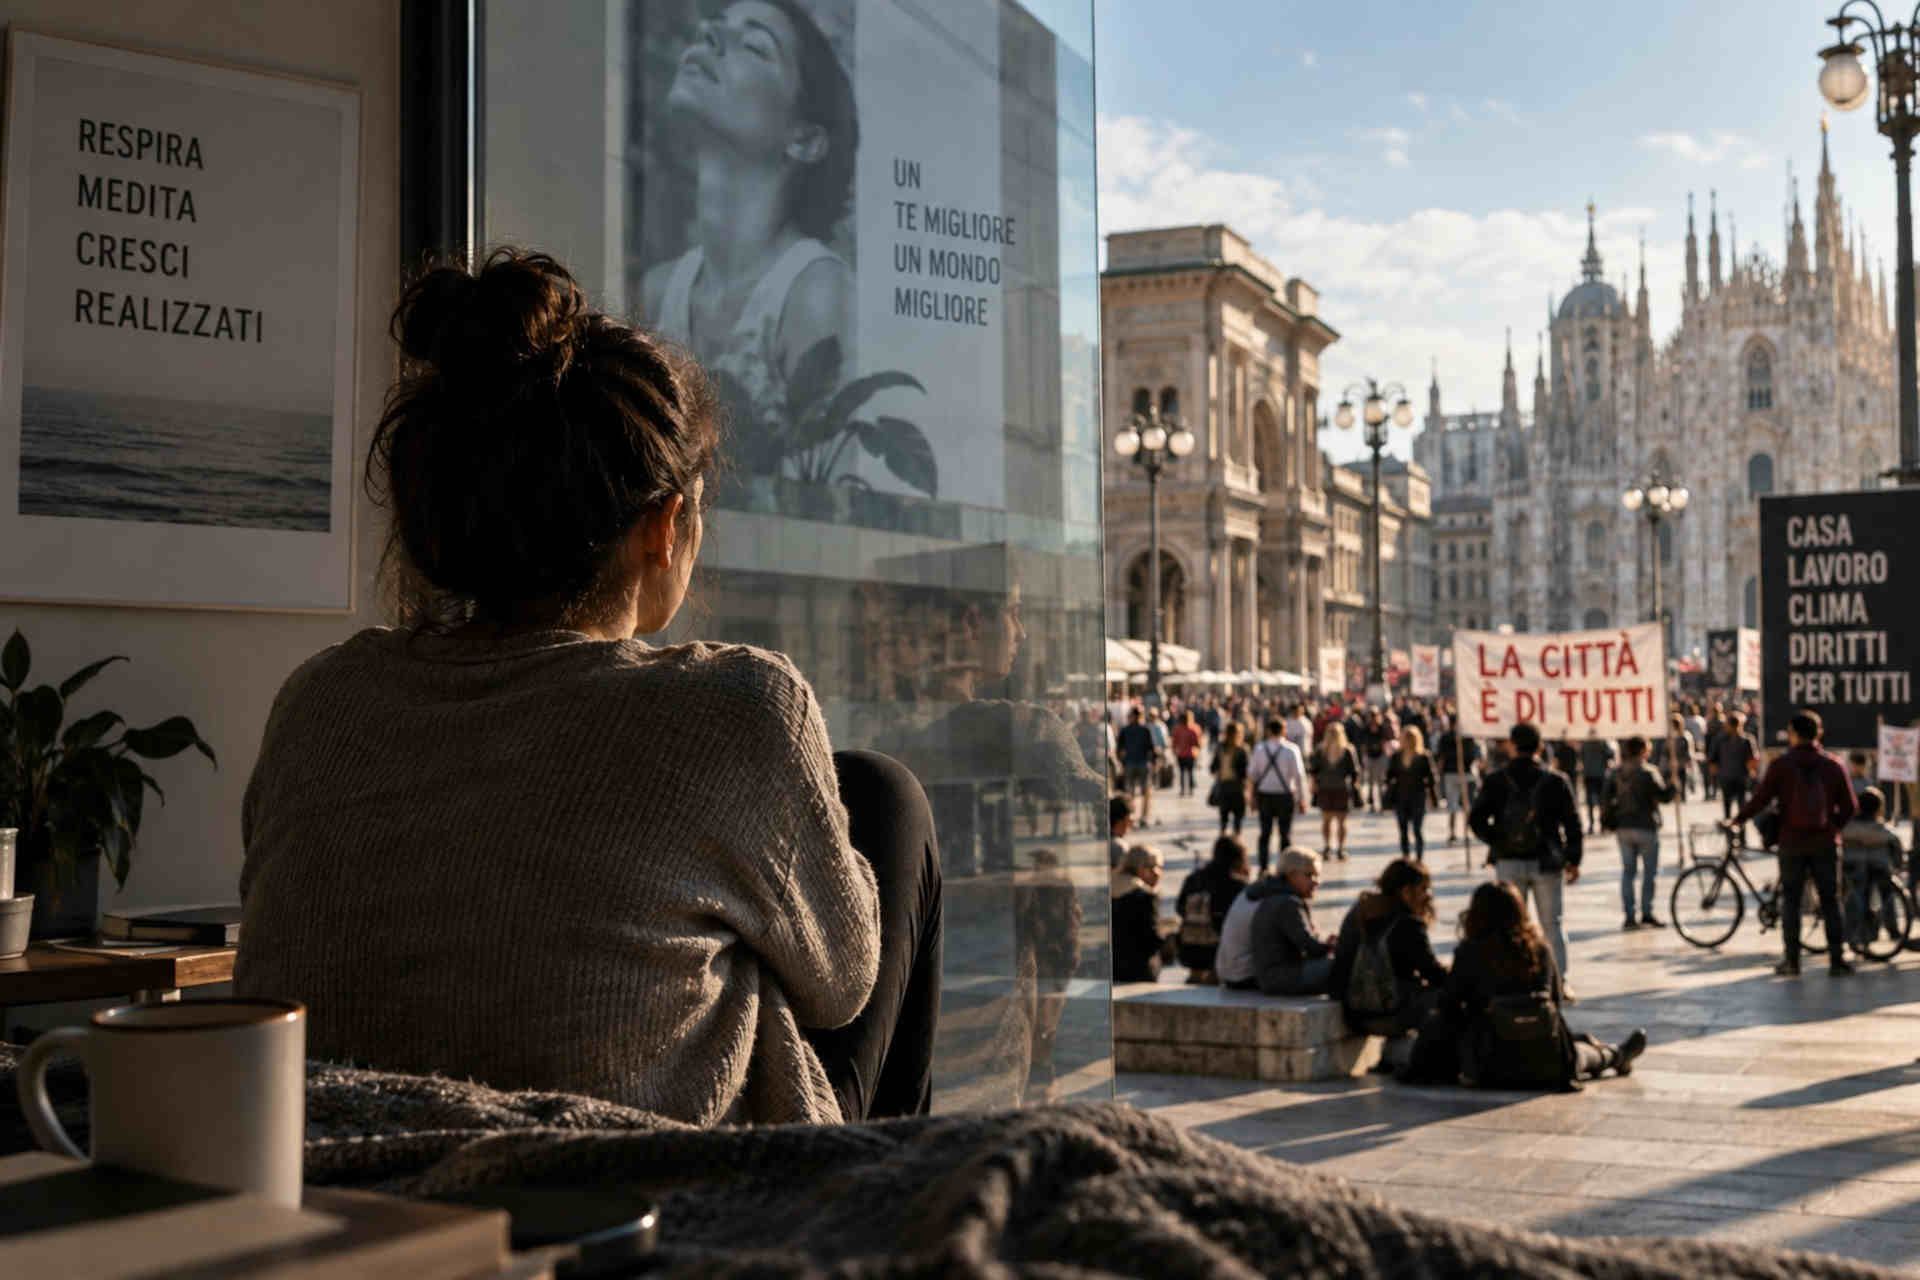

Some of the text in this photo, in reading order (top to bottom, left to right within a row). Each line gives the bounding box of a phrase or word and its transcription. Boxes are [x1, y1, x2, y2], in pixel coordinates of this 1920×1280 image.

[79, 118, 204, 171] RESPIRA
[894, 158, 921, 189] UN
[77, 174, 198, 223] MEDITA
[894, 201, 1016, 245] TE MIGLIORE
[76, 231, 190, 279] CRESCI
[894, 244, 1001, 285] UN MONDO
[75, 288, 263, 343] REALIZZATI
[895, 286, 988, 326] MIGLIORE
[1787, 513, 1853, 548] CASA
[1788, 551, 1888, 586] LAVORO
[1788, 592, 1868, 626] CLIMA
[1478, 643, 1523, 679] LA
[1541, 632, 1639, 678] CITTÀ
[1789, 630, 1888, 666] DIRITTI
[1515, 689, 1545, 724] DI
[1560, 686, 1655, 724] TUTTI
[1790, 671, 1910, 703] PER TUTTI
